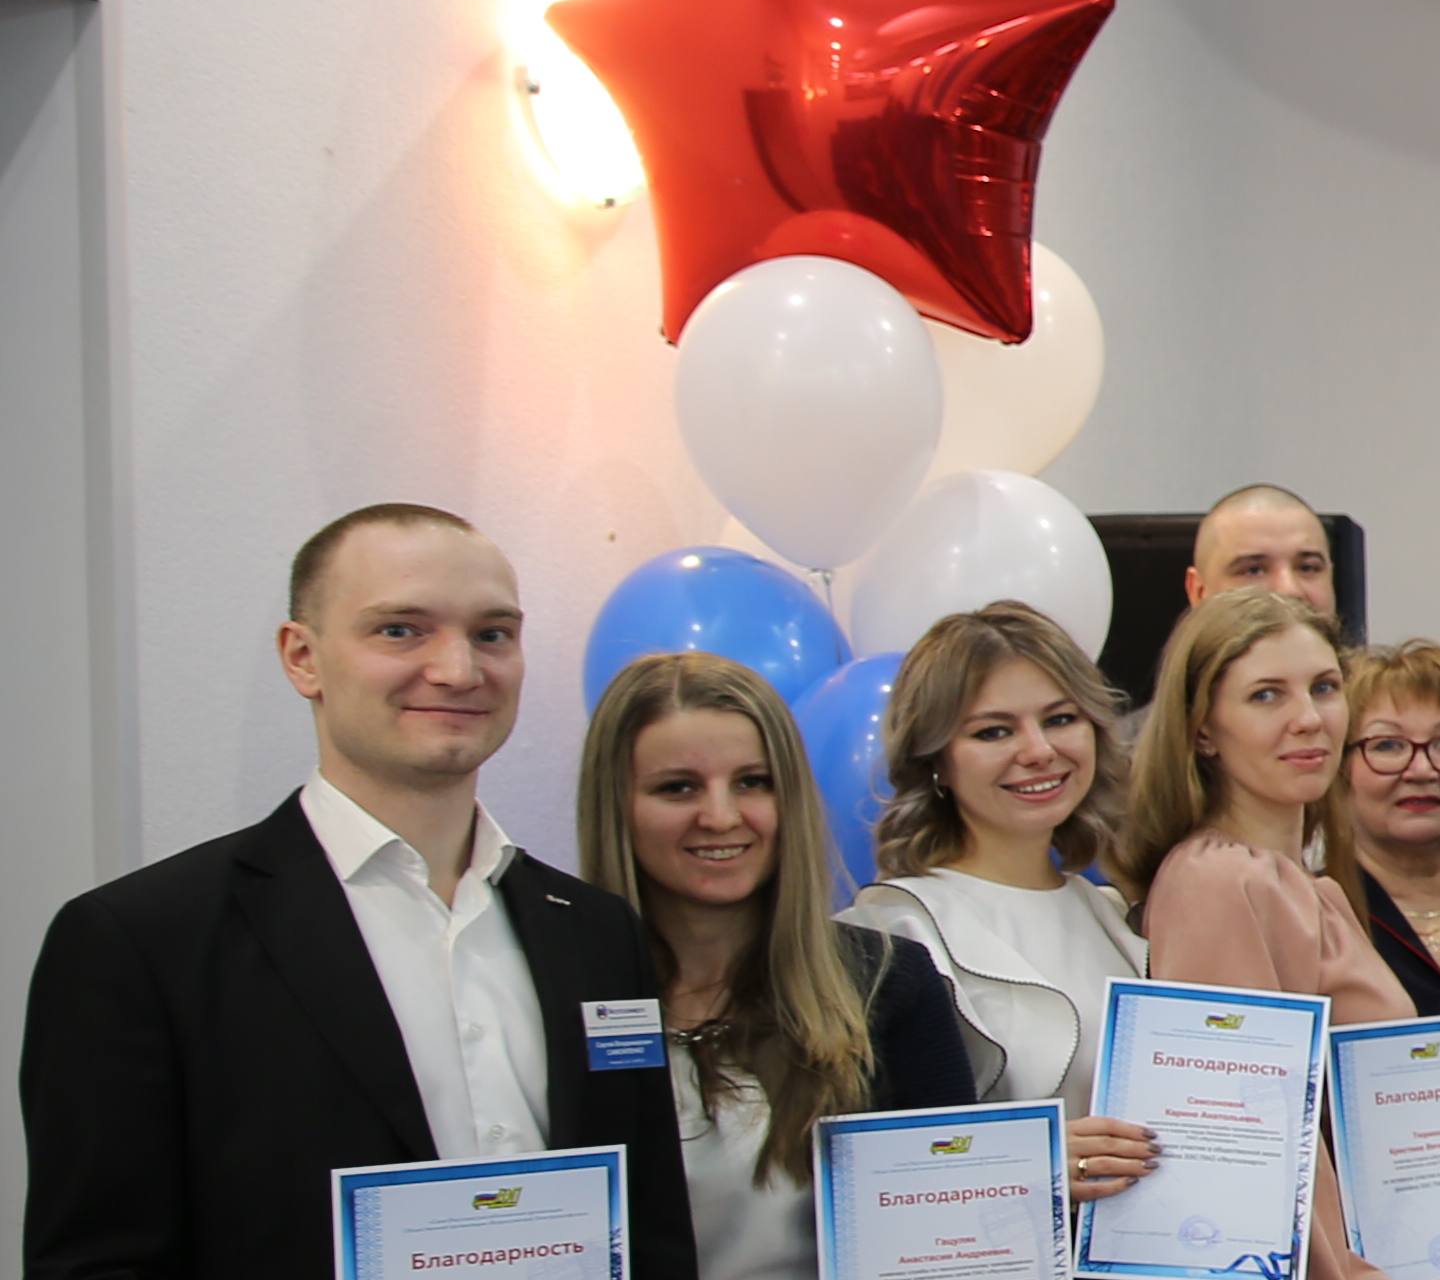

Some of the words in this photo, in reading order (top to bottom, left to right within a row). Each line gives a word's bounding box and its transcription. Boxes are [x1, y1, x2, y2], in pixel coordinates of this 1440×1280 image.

[1152, 1051, 1288, 1077] Благодарность
[879, 1184, 1029, 1207] Благодарность
[412, 1241, 585, 1270] Благодарность
